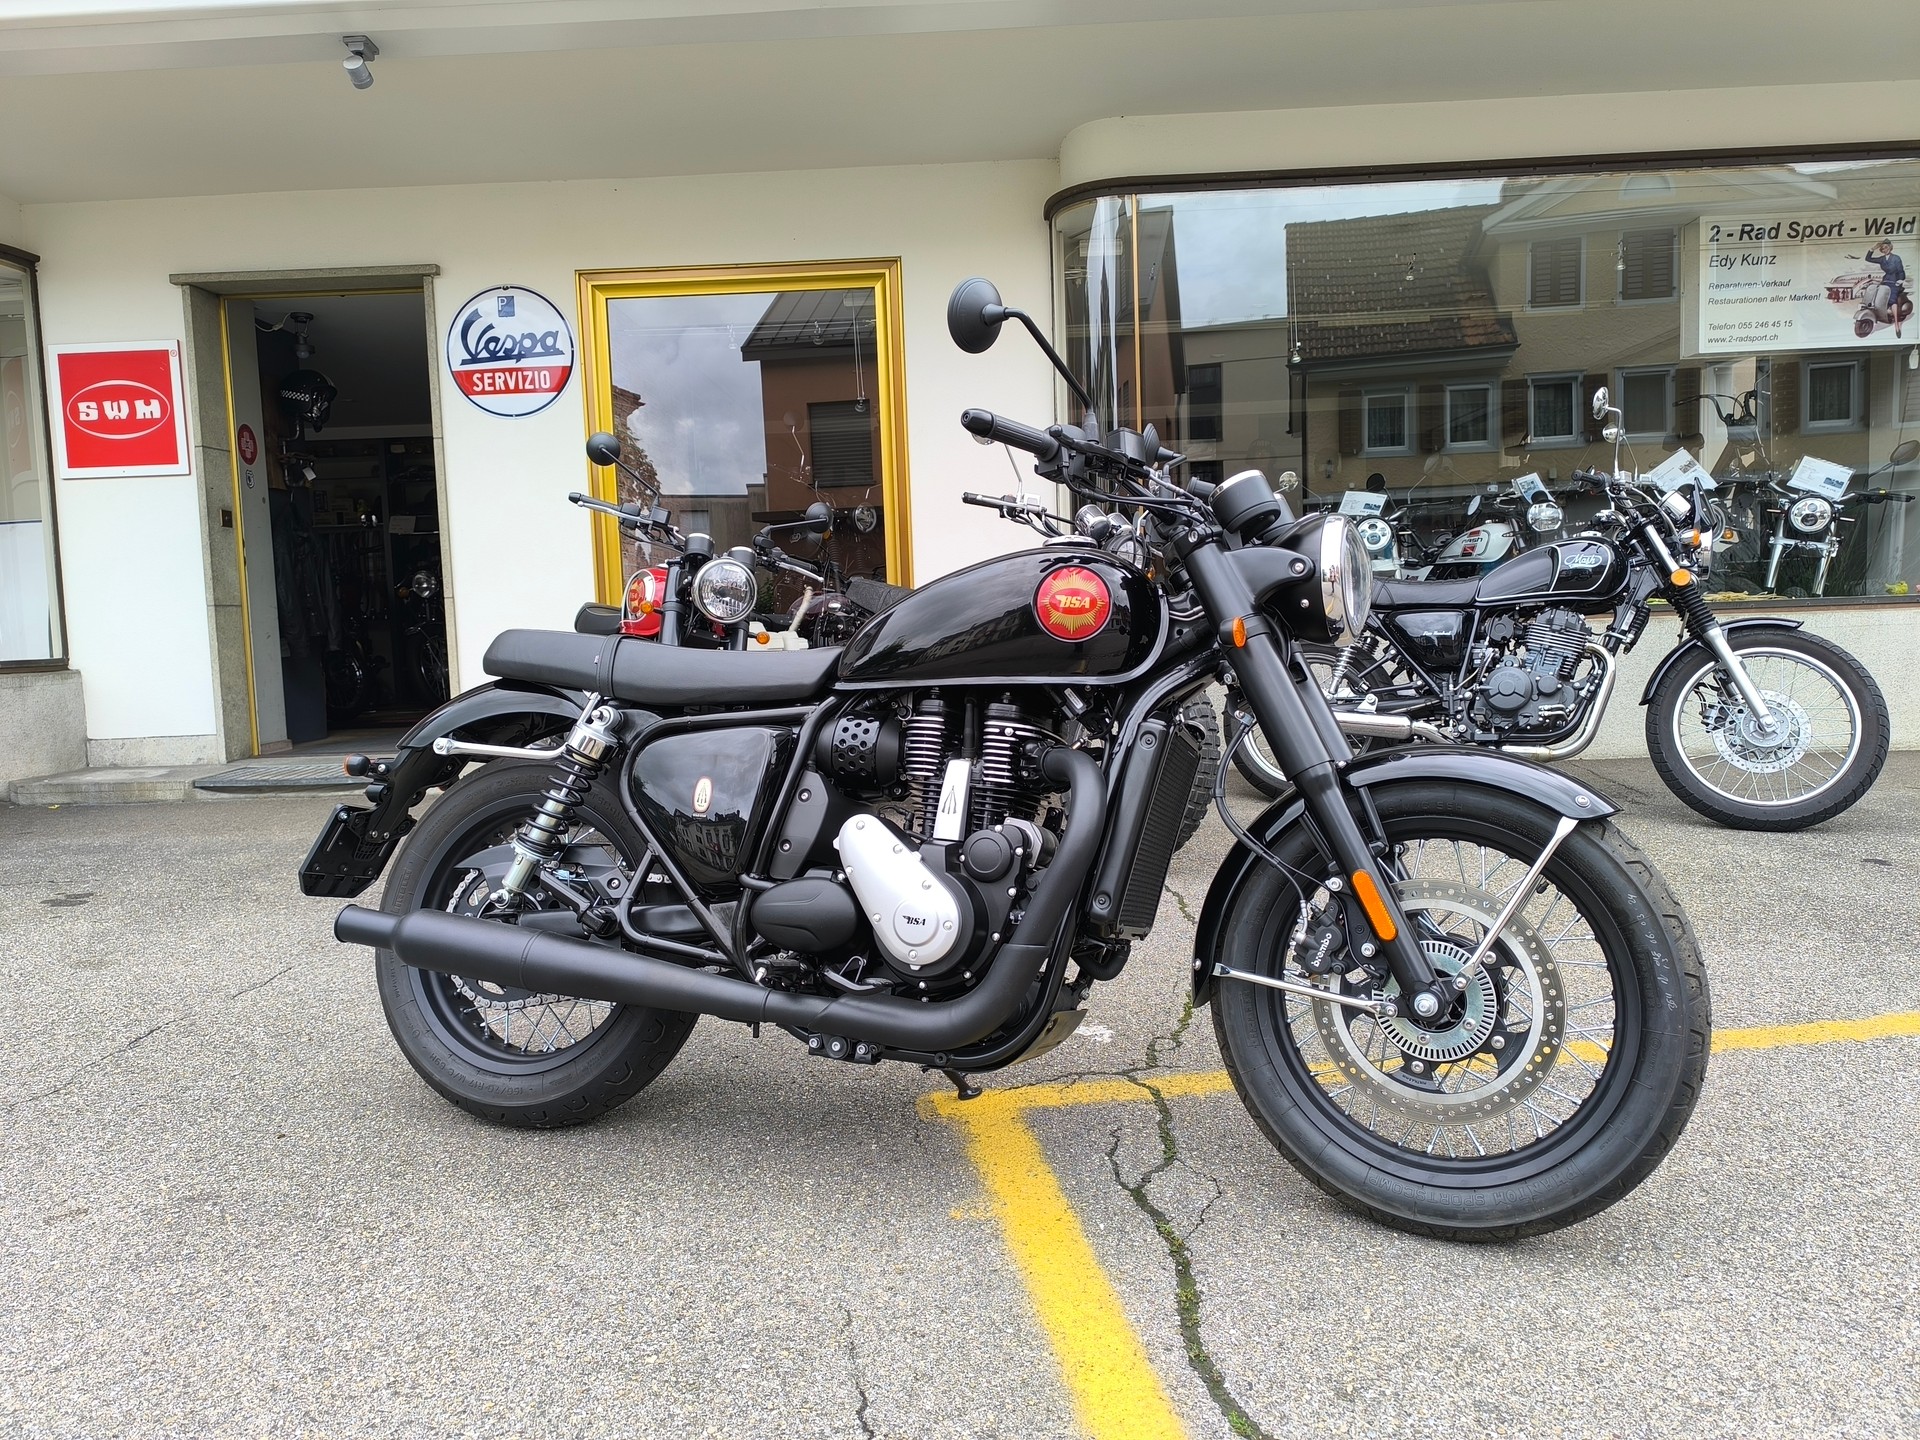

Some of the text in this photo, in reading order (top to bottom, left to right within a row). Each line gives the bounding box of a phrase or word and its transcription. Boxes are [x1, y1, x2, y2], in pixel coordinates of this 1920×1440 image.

[1709, 225, 1721, 242] 2
[1739, 222, 1782, 241] Rad
[1787, 220, 1845, 243] Sport
[1864, 216, 1917, 236] Wald
[1709, 252, 1777, 270] Edy Kunz
[1708, 279, 1792, 291] Reparaturen-Verkauf
[1707, 293, 1821, 306] Restaurationen aller Marken!
[1708, 319, 1793, 332] Telefon 055 246 45 15
[460, 307, 565, 366] Vespa
[1708, 333, 1779, 344] www.2-radsport.ch
[472, 370, 551, 392] SERVIZIO
[77, 398, 162, 422] SWM
[1055, 594, 1090, 609] BSA
[902, 915, 926, 926] BSA
[1311, 933, 1332, 968] brembo
[1368, 1163, 1581, 1209] PHANTOM SPORTSCOMP
